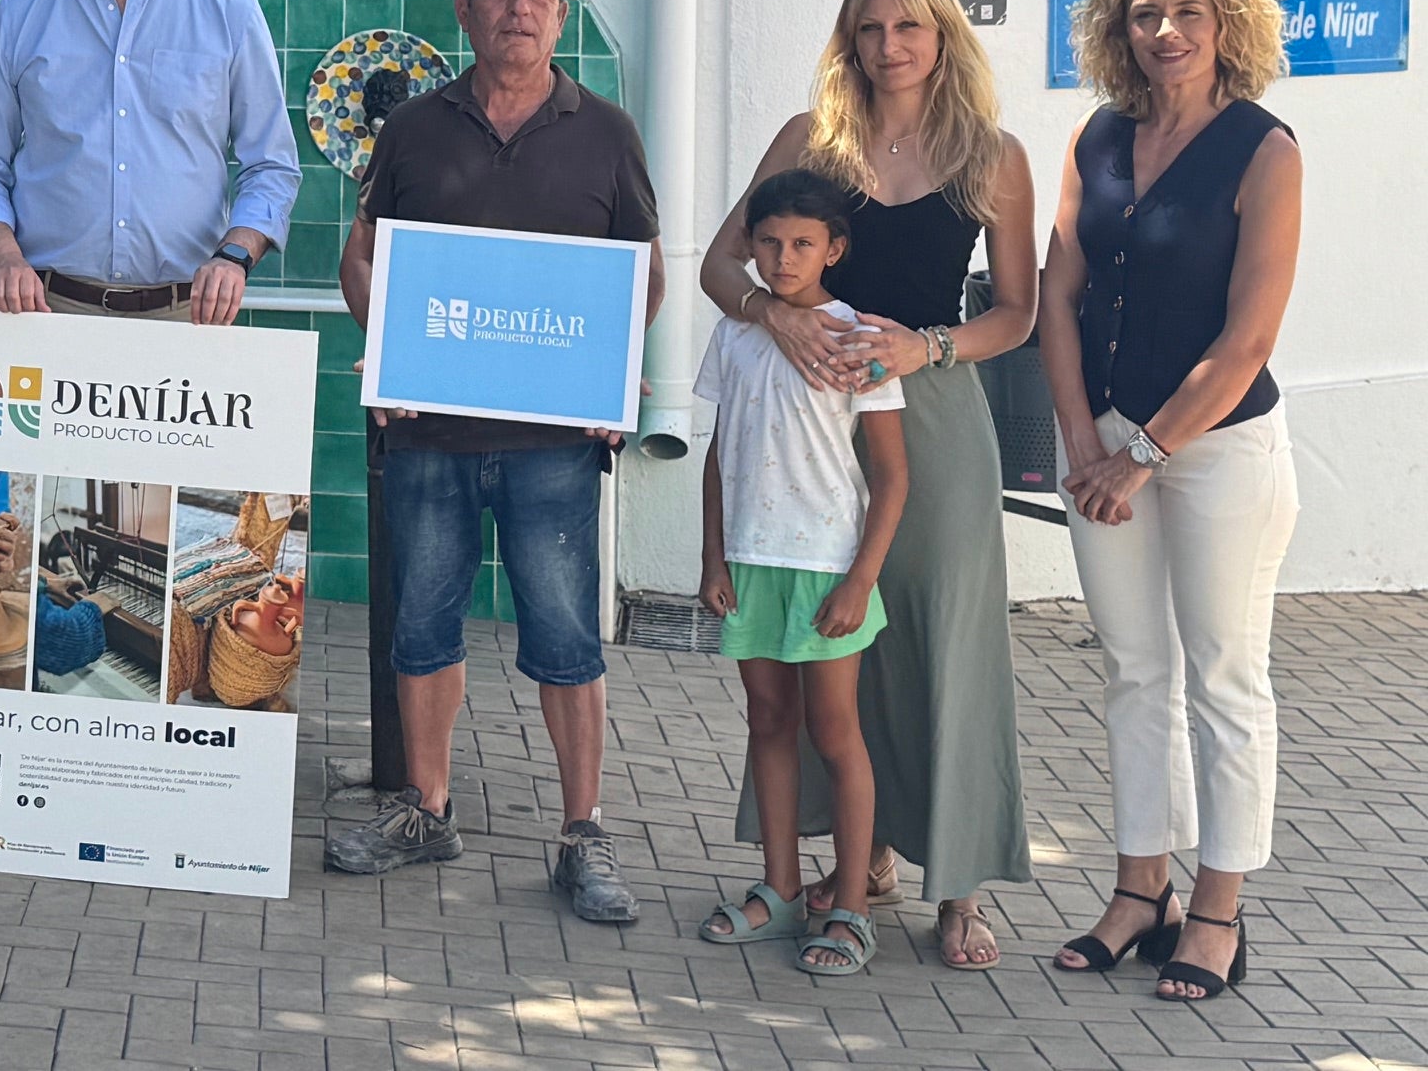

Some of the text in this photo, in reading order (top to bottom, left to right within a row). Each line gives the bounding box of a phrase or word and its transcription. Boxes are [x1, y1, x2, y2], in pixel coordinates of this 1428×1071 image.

[1289, 1, 1379, 48] de Níjar
[472, 306, 585, 337] DENÍJAR
[474, 329, 573, 348] PRODUCTO LOCAL
[51, 378, 254, 430] DENÍJAR
[53, 422, 215, 448] PRODUCTO LOCAL
[31, 715, 79, 735] con
[89, 716, 155, 741] alma
[164, 721, 236, 748] local
[19, 763, 51, 772] productos
[51, 766, 85, 775] elaborados
[91, 770, 123, 779] fabricados
[19, 772, 62, 782] sostenibilidad
[94, 761, 139, 771] Ayuntamiento
[188, 859, 271, 874] Ayuntamiento de Níjar
